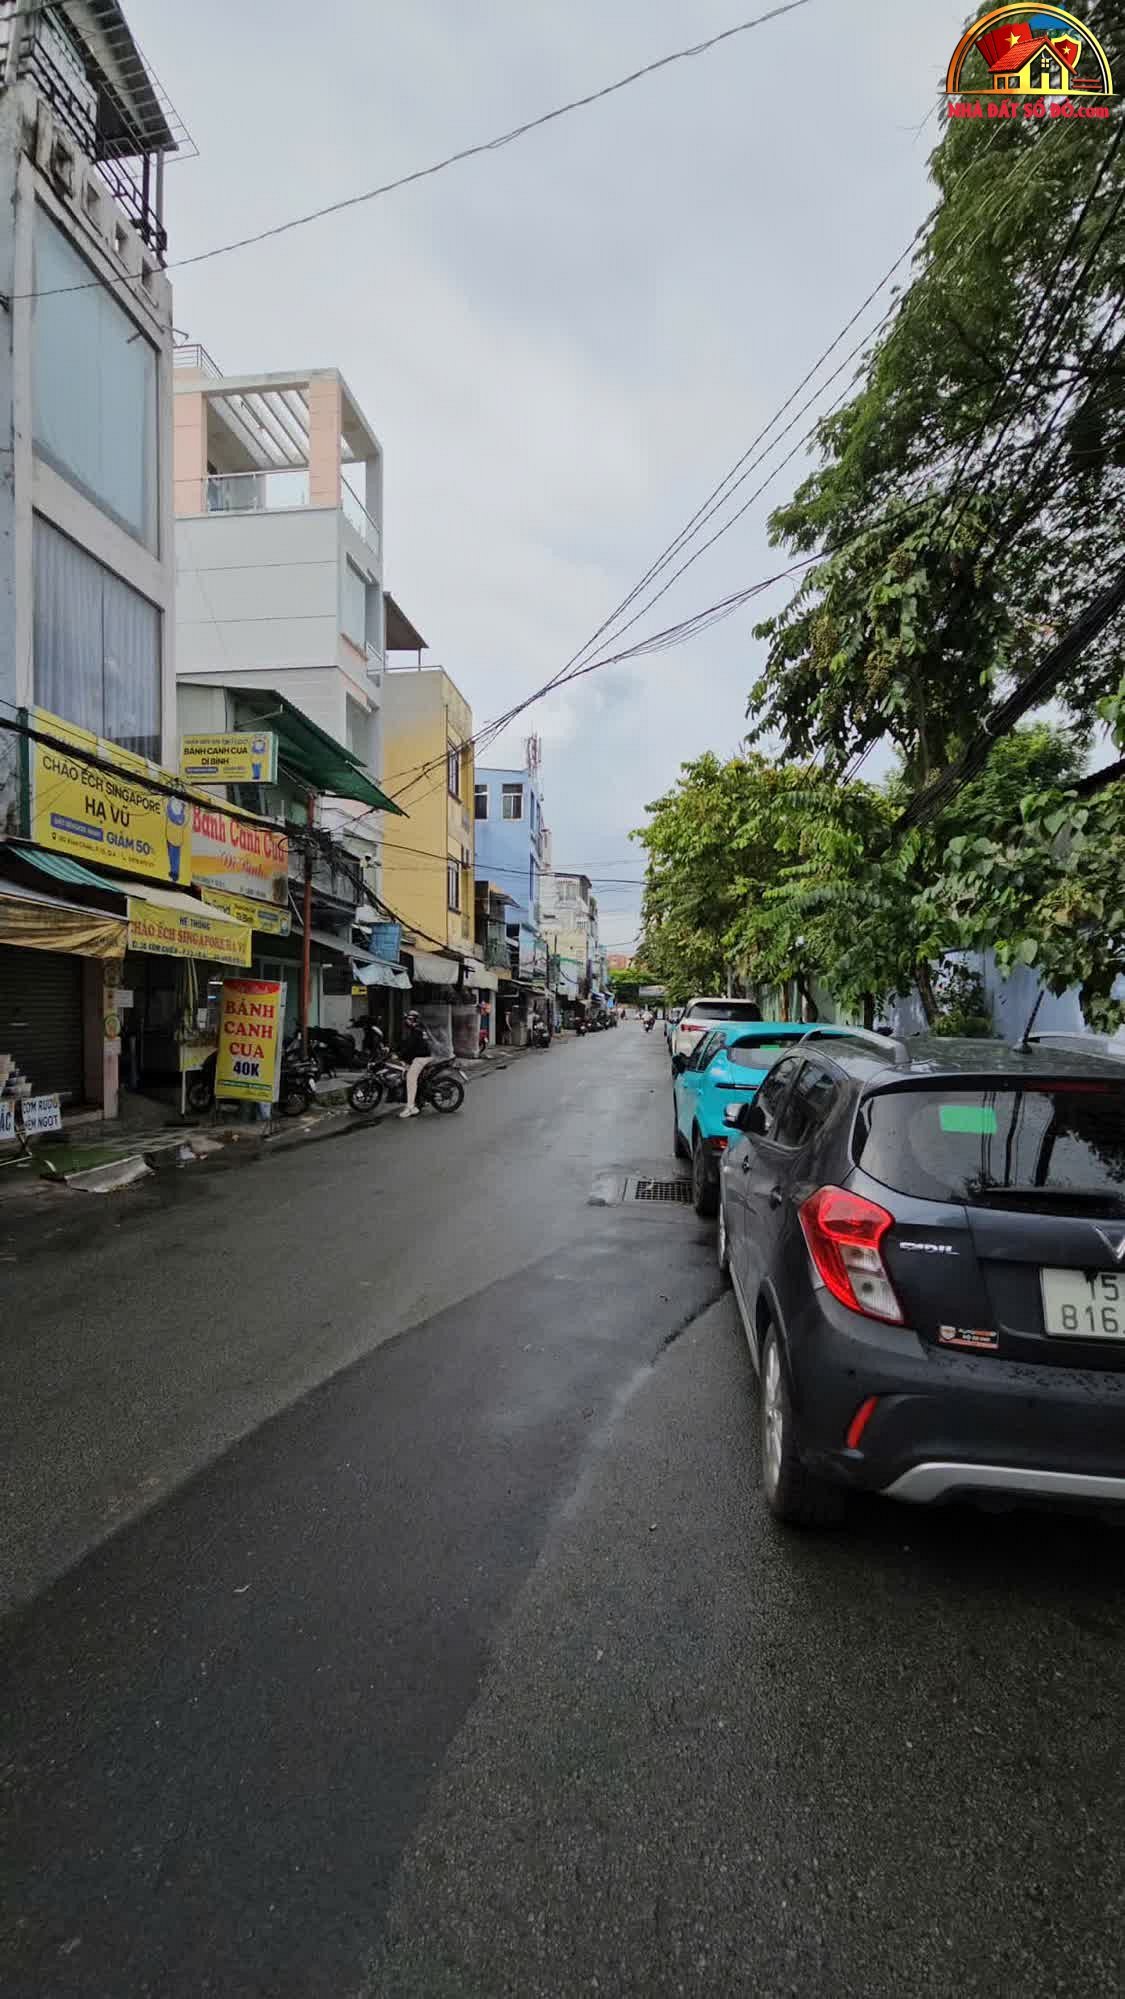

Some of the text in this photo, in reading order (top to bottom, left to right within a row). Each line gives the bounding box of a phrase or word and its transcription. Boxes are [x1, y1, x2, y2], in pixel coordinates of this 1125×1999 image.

[207, 746, 230, 755] CANH
[231, 746, 248, 755] CUA
[105, 781, 161, 815] SINGAPORE
[84, 795, 130, 827] HẠ VŨ
[230, 817, 261, 856] Canh
[223, 1021, 273, 1039] CANH
[229, 1042, 265, 1059] CUA
[233, 1062, 260, 1077] 40K
